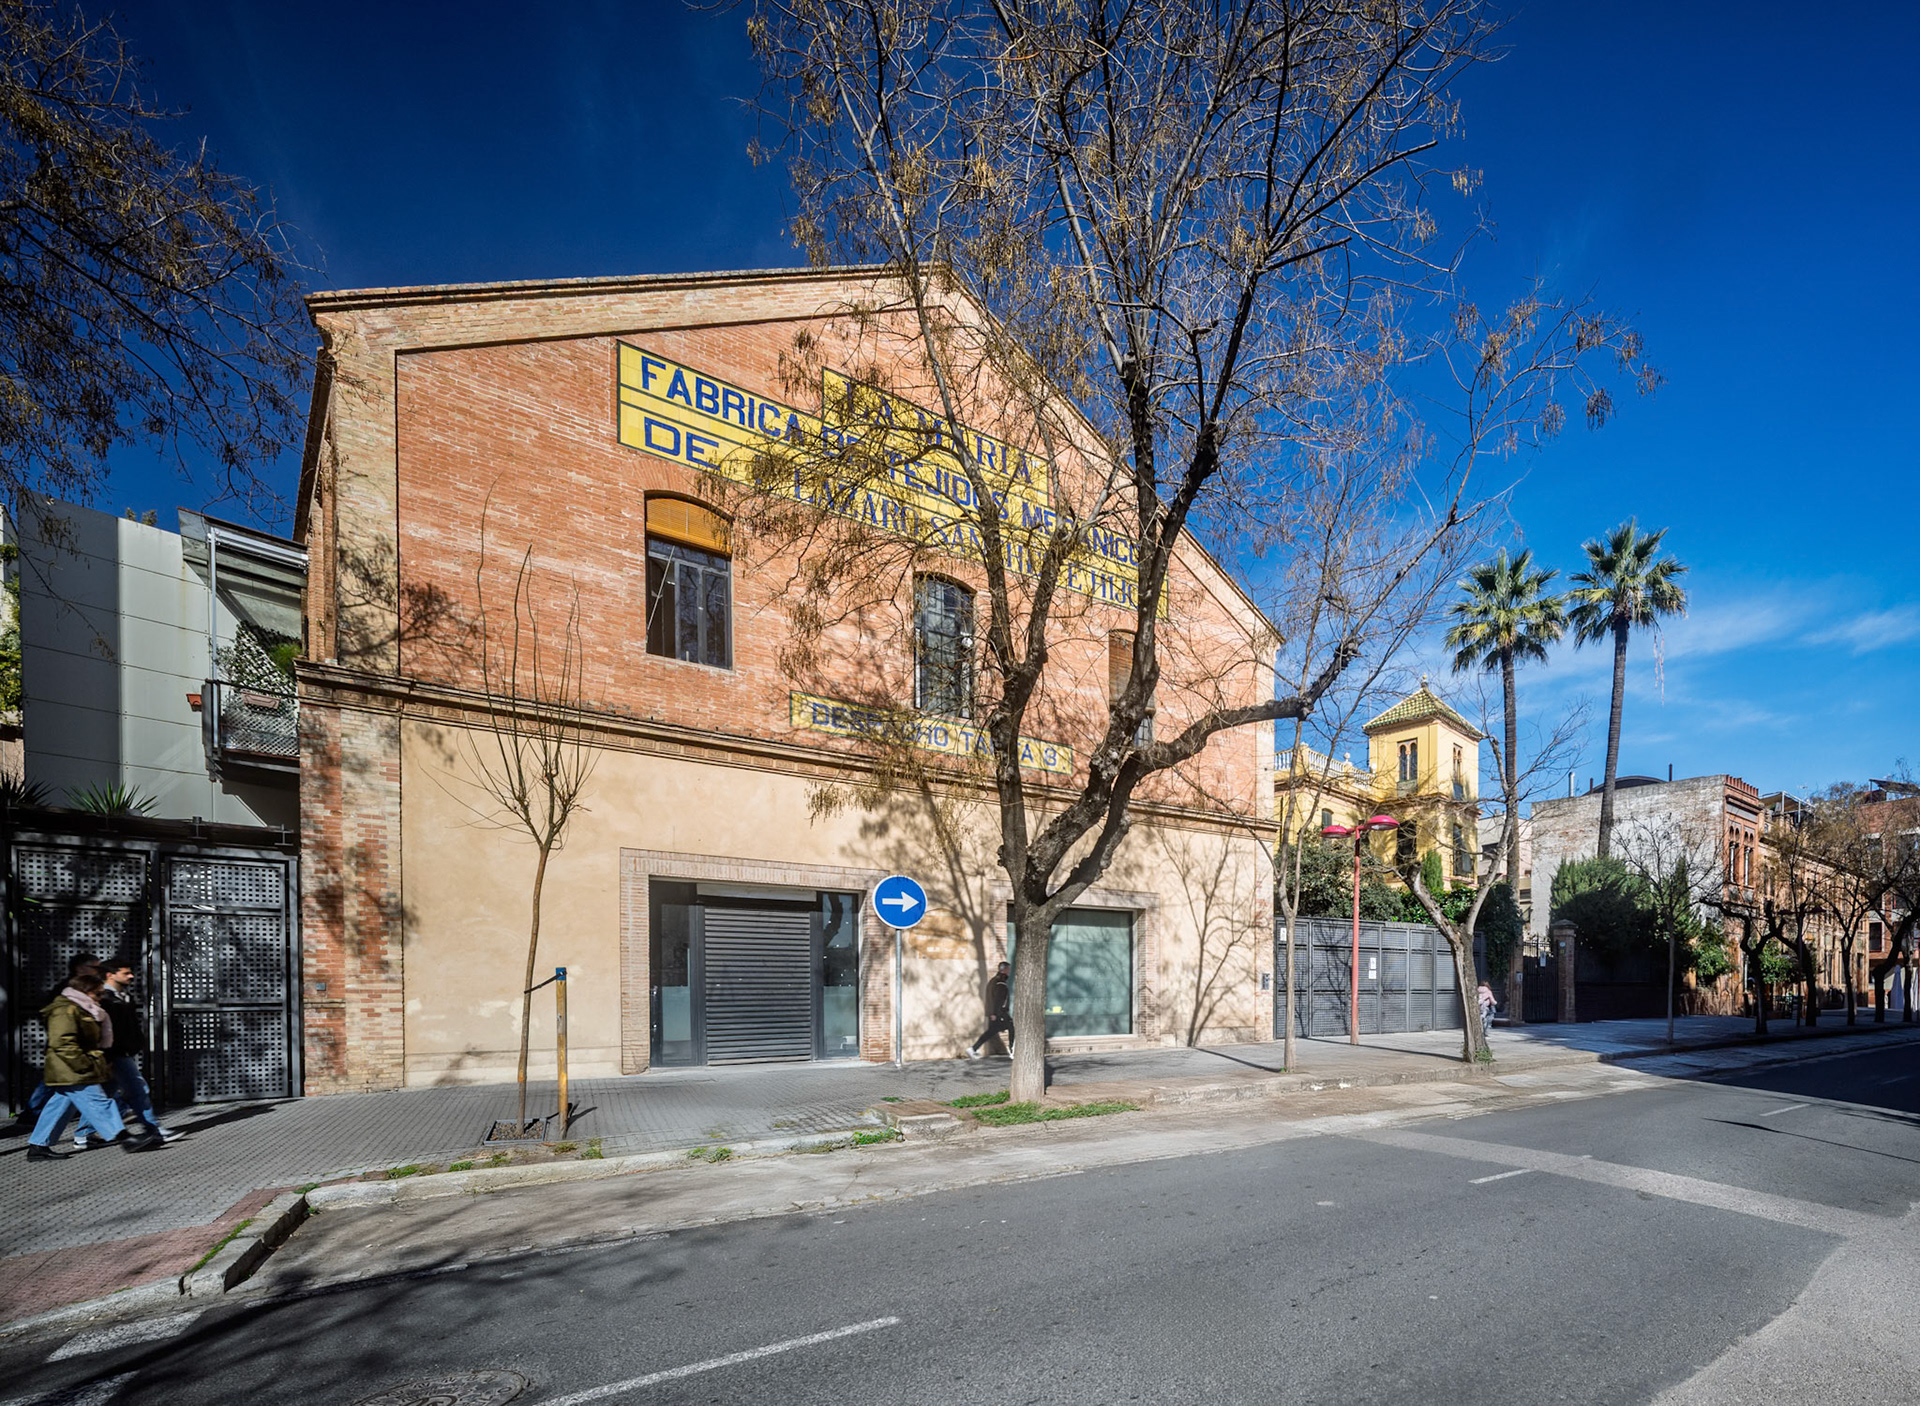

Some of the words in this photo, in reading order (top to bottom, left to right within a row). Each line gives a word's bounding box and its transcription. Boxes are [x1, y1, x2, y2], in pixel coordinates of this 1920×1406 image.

[914, 410, 1032, 485] MRIA
[643, 416, 720, 471] DE
[1091, 569, 1139, 609] HIJO
[812, 702, 948, 747] DESPCHO
